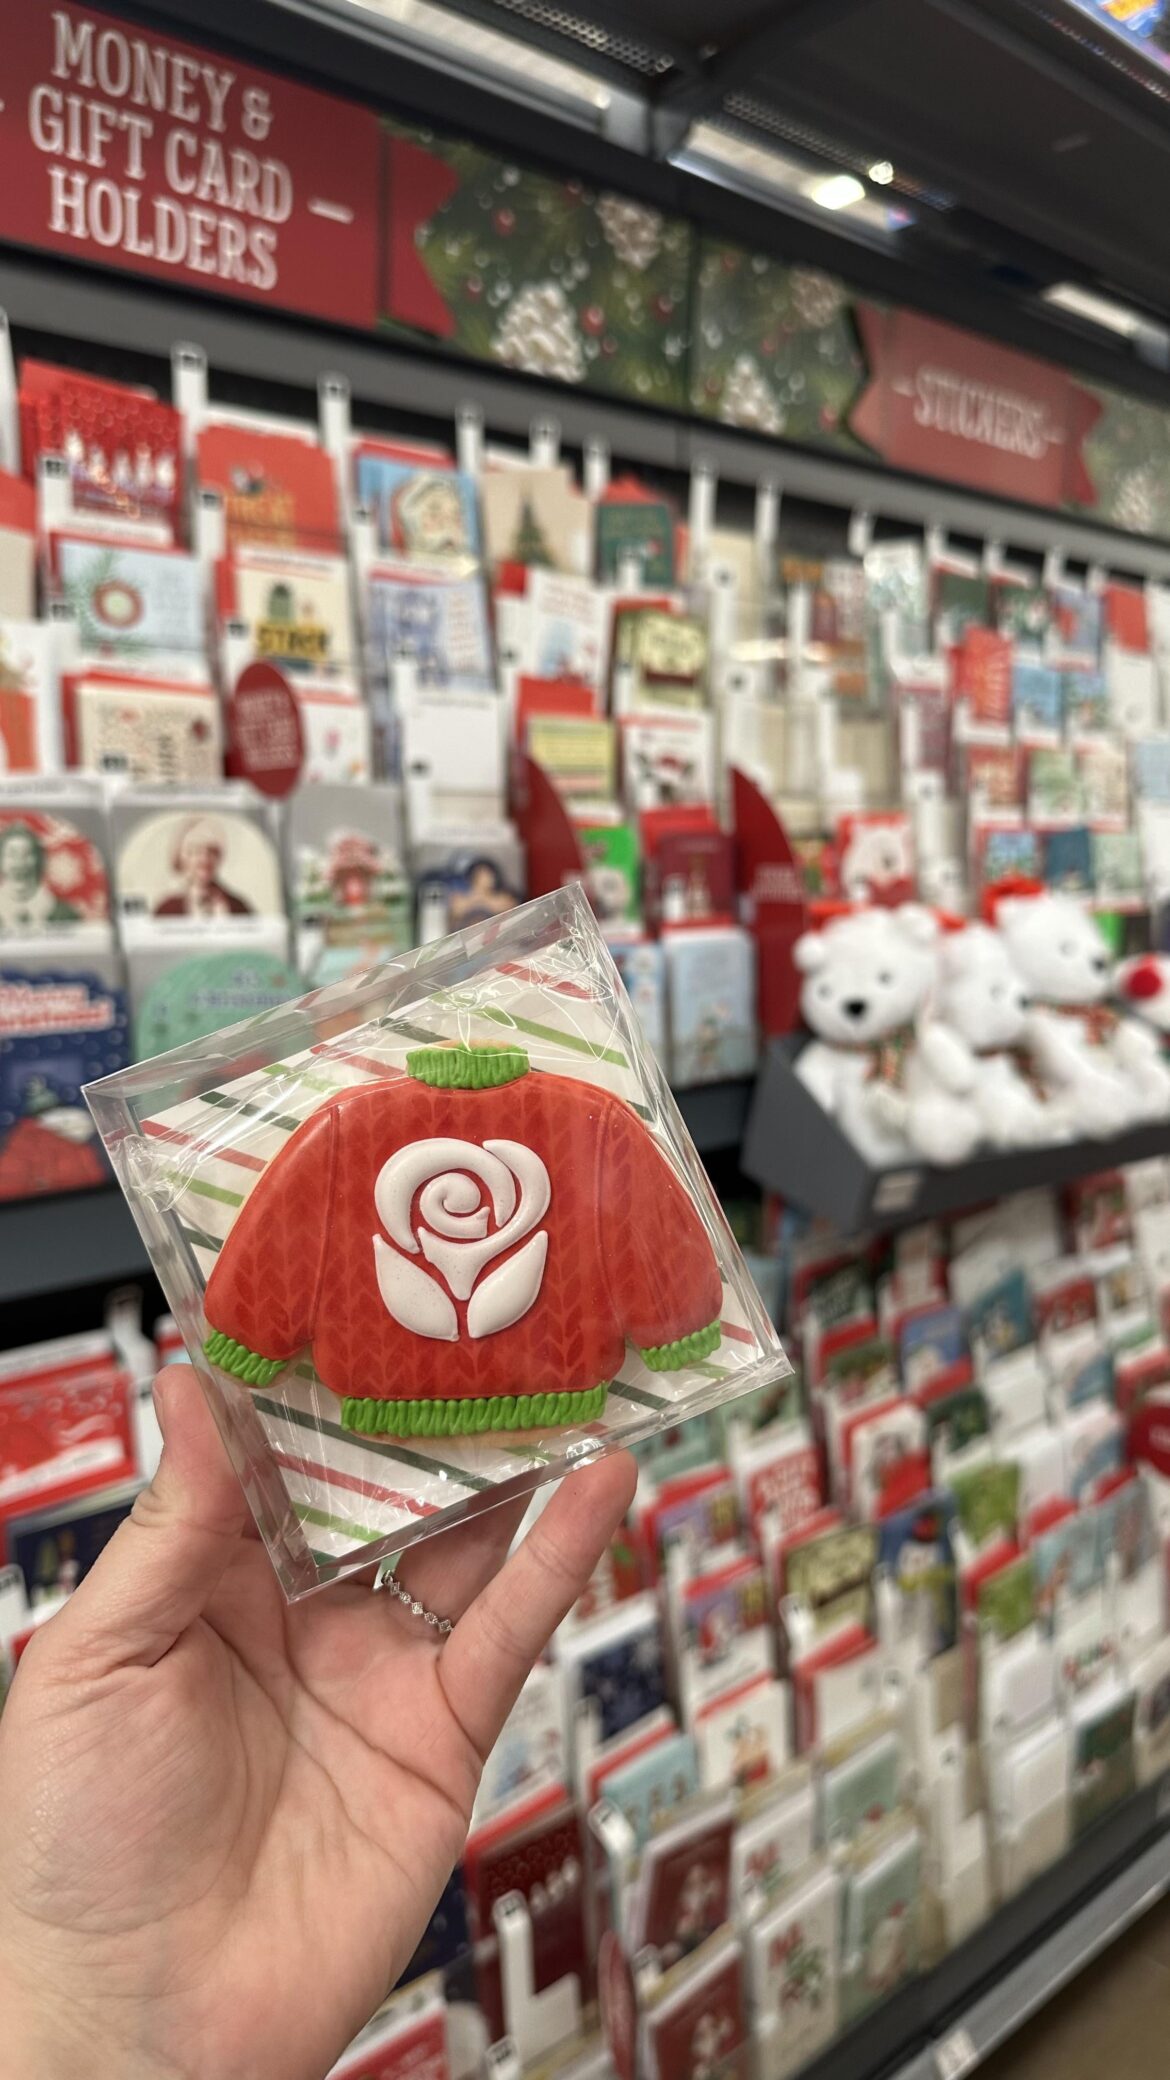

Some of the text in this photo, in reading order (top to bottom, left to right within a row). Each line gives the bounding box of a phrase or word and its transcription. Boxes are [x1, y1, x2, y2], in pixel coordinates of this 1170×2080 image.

[51, 11, 274, 141] MONEY &
[28, 83, 293, 224] GIFT CARD
[47, 165, 278, 290] HOLDERS
